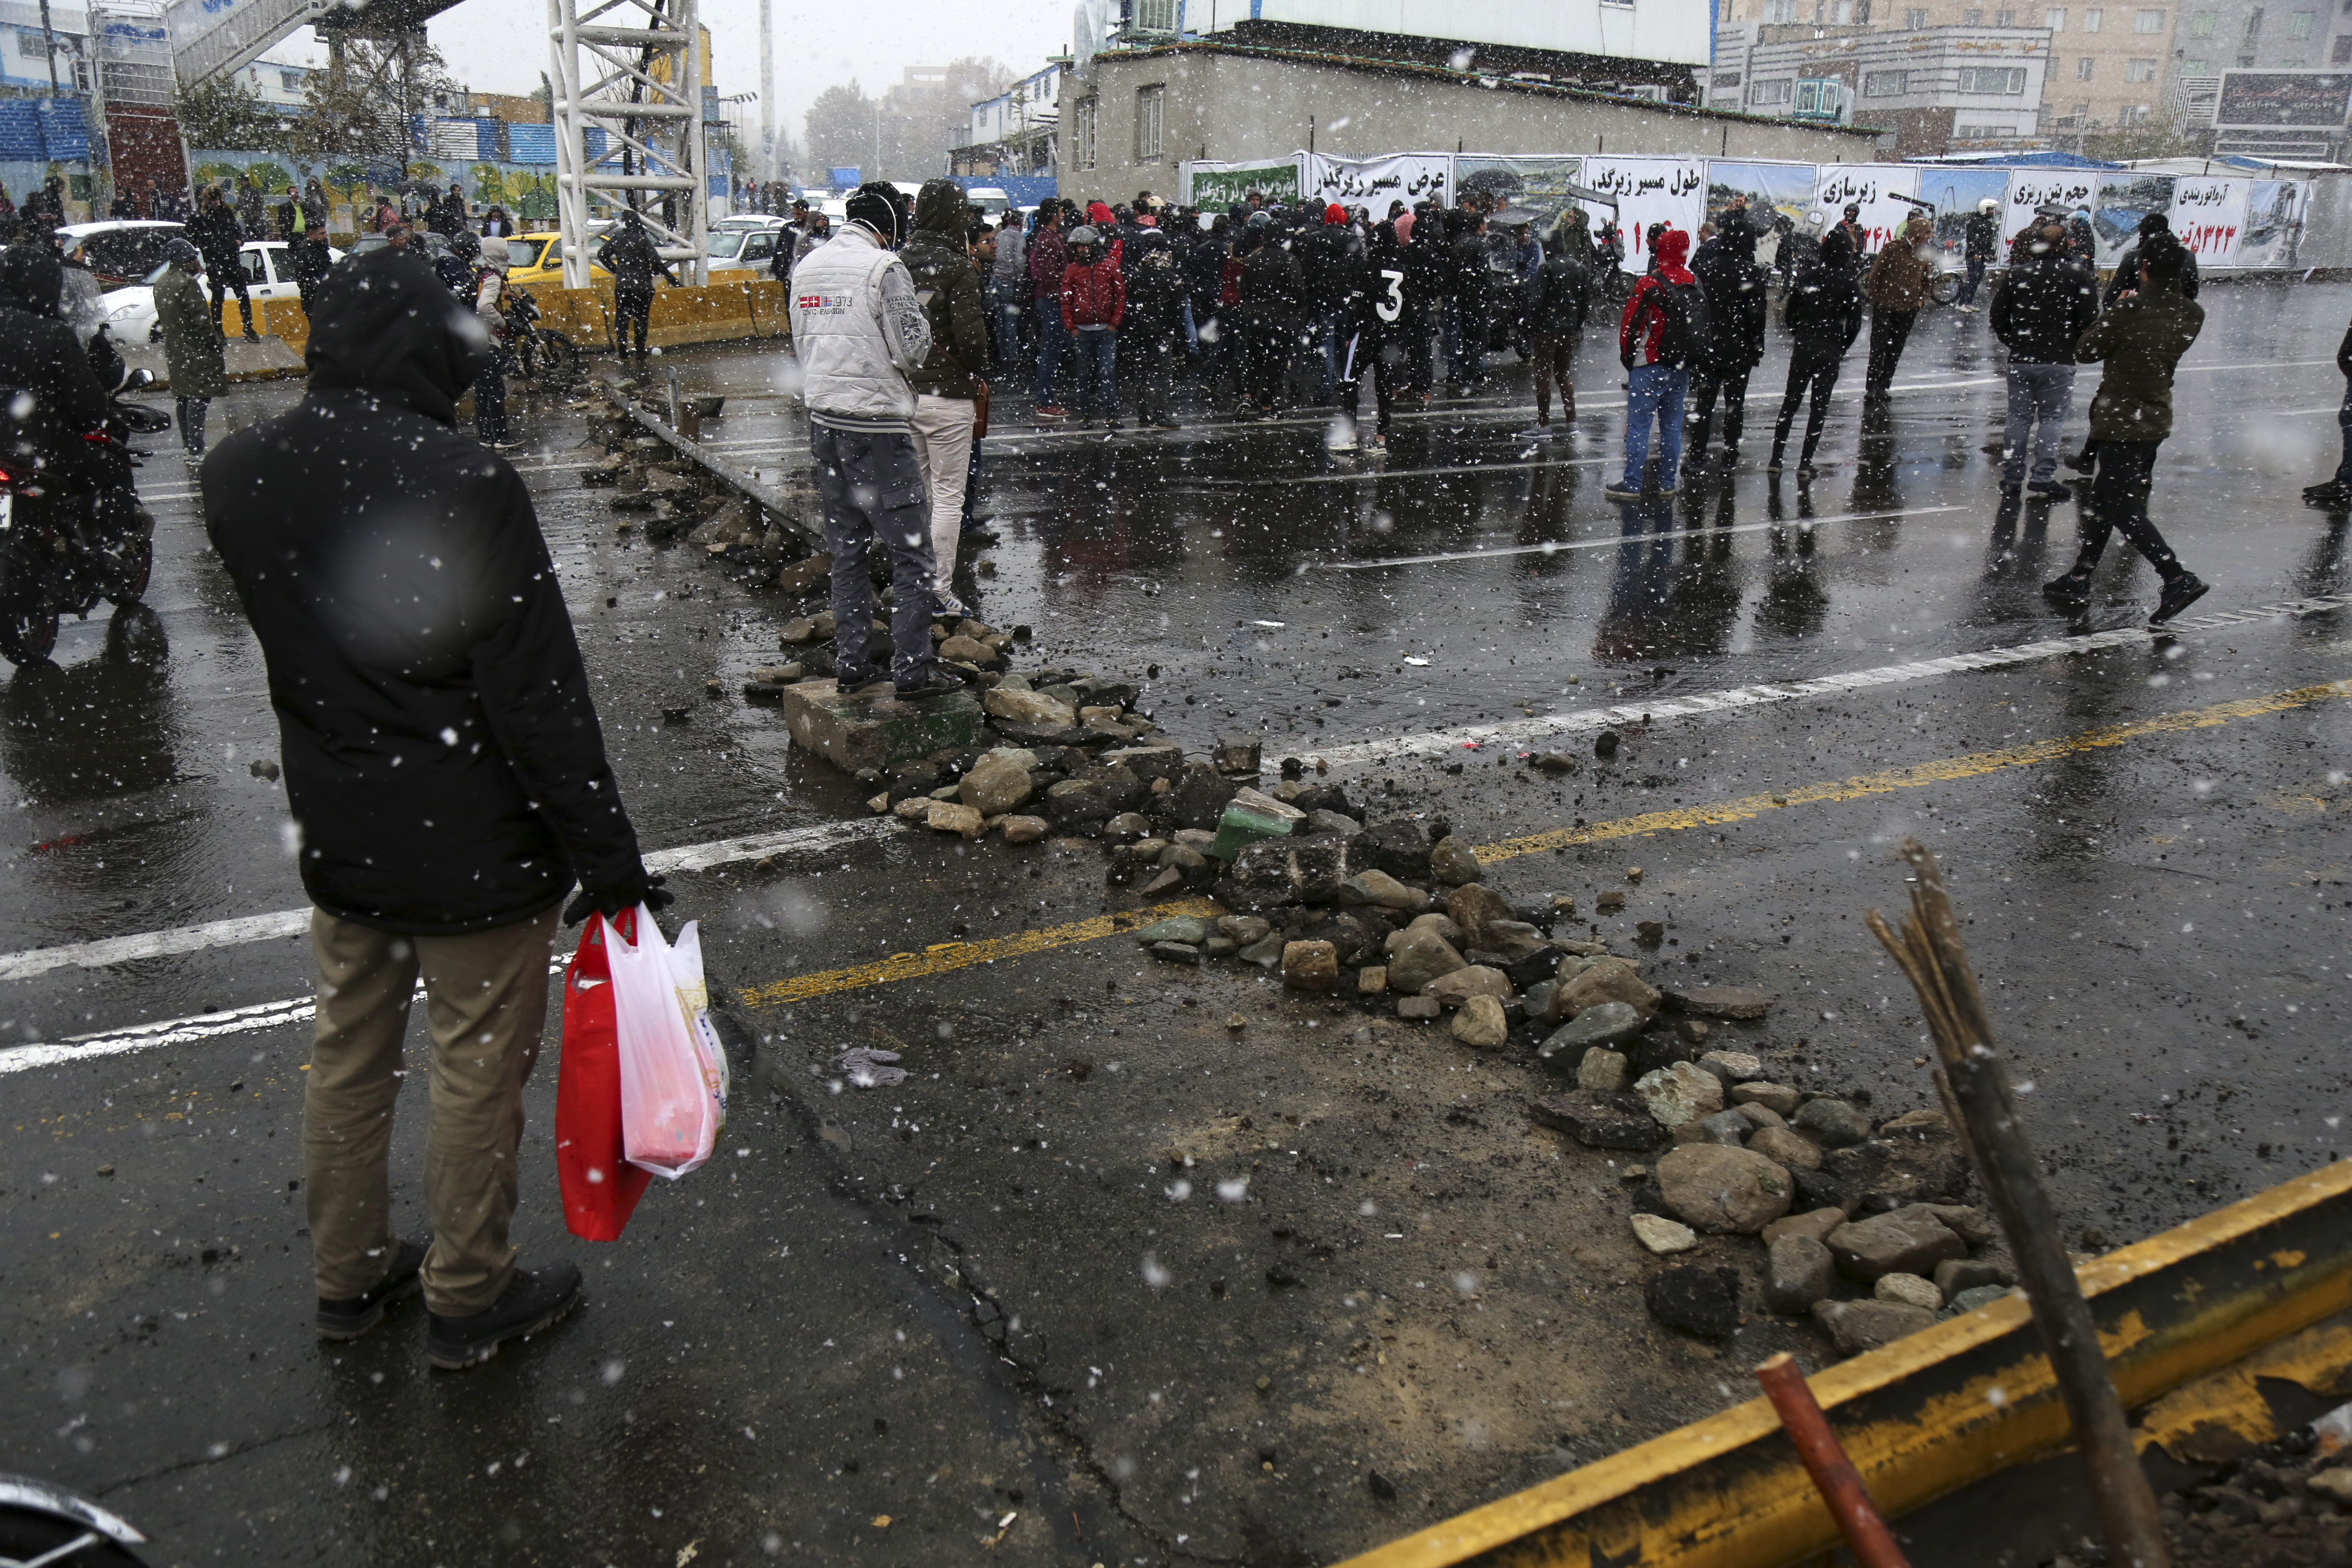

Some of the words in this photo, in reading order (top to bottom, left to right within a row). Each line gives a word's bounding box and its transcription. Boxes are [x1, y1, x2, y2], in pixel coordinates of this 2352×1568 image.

[1366, 175, 1401, 197] مسیر
[1408, 167, 1445, 197] عرض
[1635, 176, 1665, 196] مسیر
[1670, 168, 1700, 197] طول
[2064, 185, 2089, 205] حجم
[833, 296, 852, 307] 1973
[1376, 270, 1403, 321] 3
